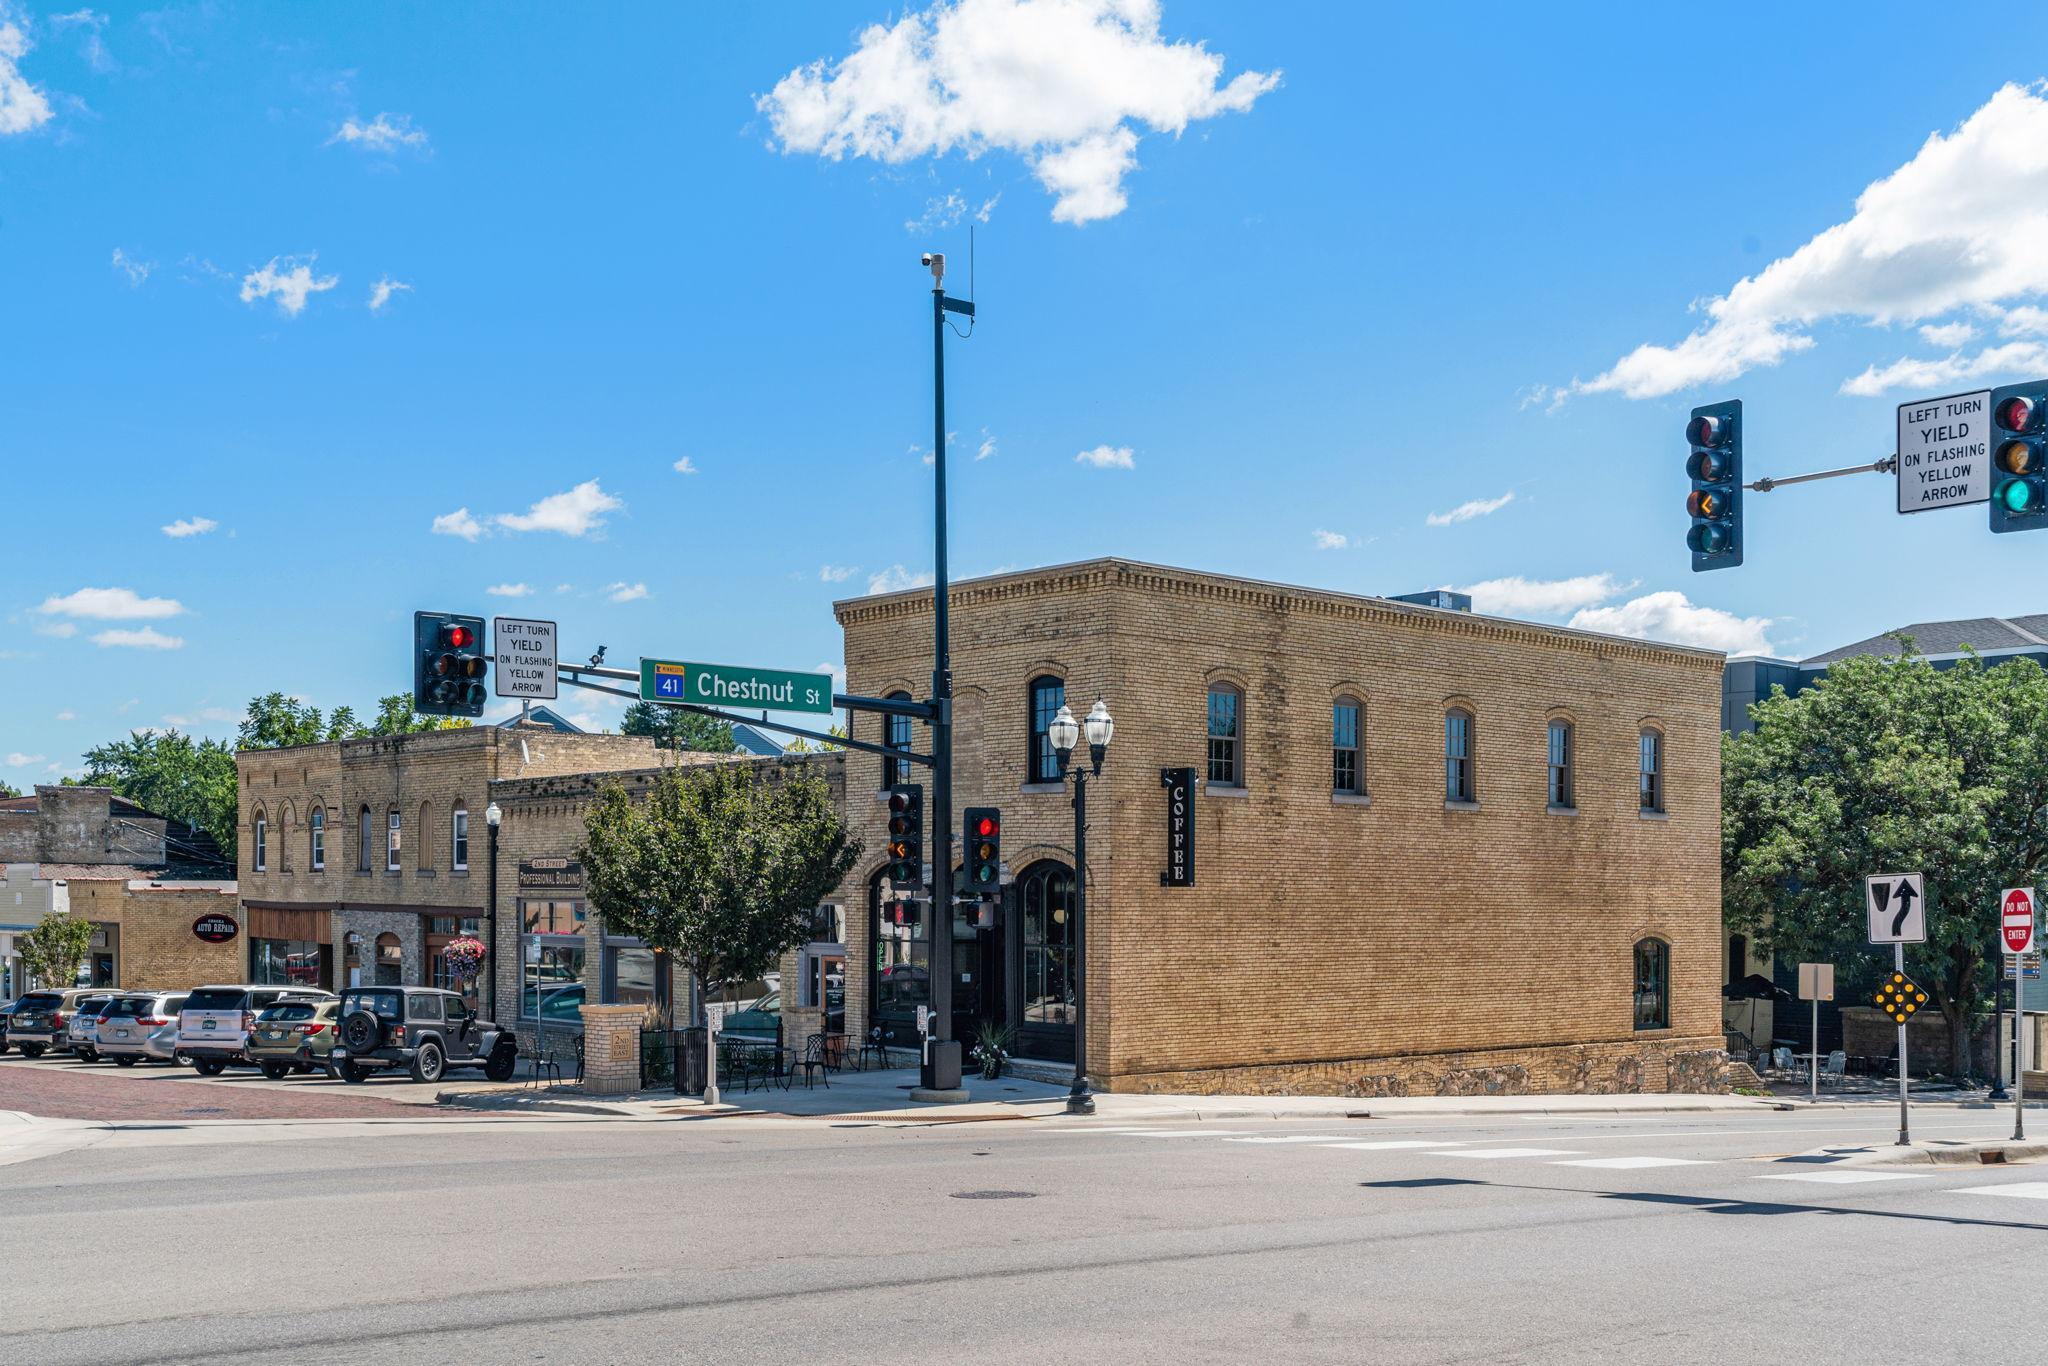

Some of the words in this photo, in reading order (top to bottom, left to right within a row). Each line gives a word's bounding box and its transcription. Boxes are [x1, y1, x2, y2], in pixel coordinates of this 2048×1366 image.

[1908, 406, 1940, 424] LEFT
[1946, 399, 1982, 417] TURN
[1921, 422, 1969, 444] YIELD
[1904, 453, 1920, 467] ON
[1927, 443, 1985, 463] FLASHING
[1918, 464, 1972, 483] YELLOW
[1921, 484, 1968, 502] ARROW
[502, 624, 523, 634] LEFT
[527, 625, 550, 636] TURN
[510, 639, 542, 651] YIELD
[500, 654, 511, 664] ON
[515, 655, 552, 667] FLASHING
[509, 668, 544, 679] YELLOW
[511, 682, 542, 692] ARROW
[662, 678, 678, 693] 41
[697, 672, 794, 703] Chestnut
[805, 688, 820, 705] St
[1173, 786, 1184, 880] COFFEE
[520, 871, 555, 884] PROFESSIONAL
[556, 871, 580, 884] BUILDING
[2006, 902, 2015, 912] DO
[2016, 901, 2029, 912] NOT
[196, 923, 212, 932] AUTO
[213, 924, 234, 933] REPAIR
[2008, 930, 2026, 940] ENTER
[614, 1035, 630, 1044] 2ND
